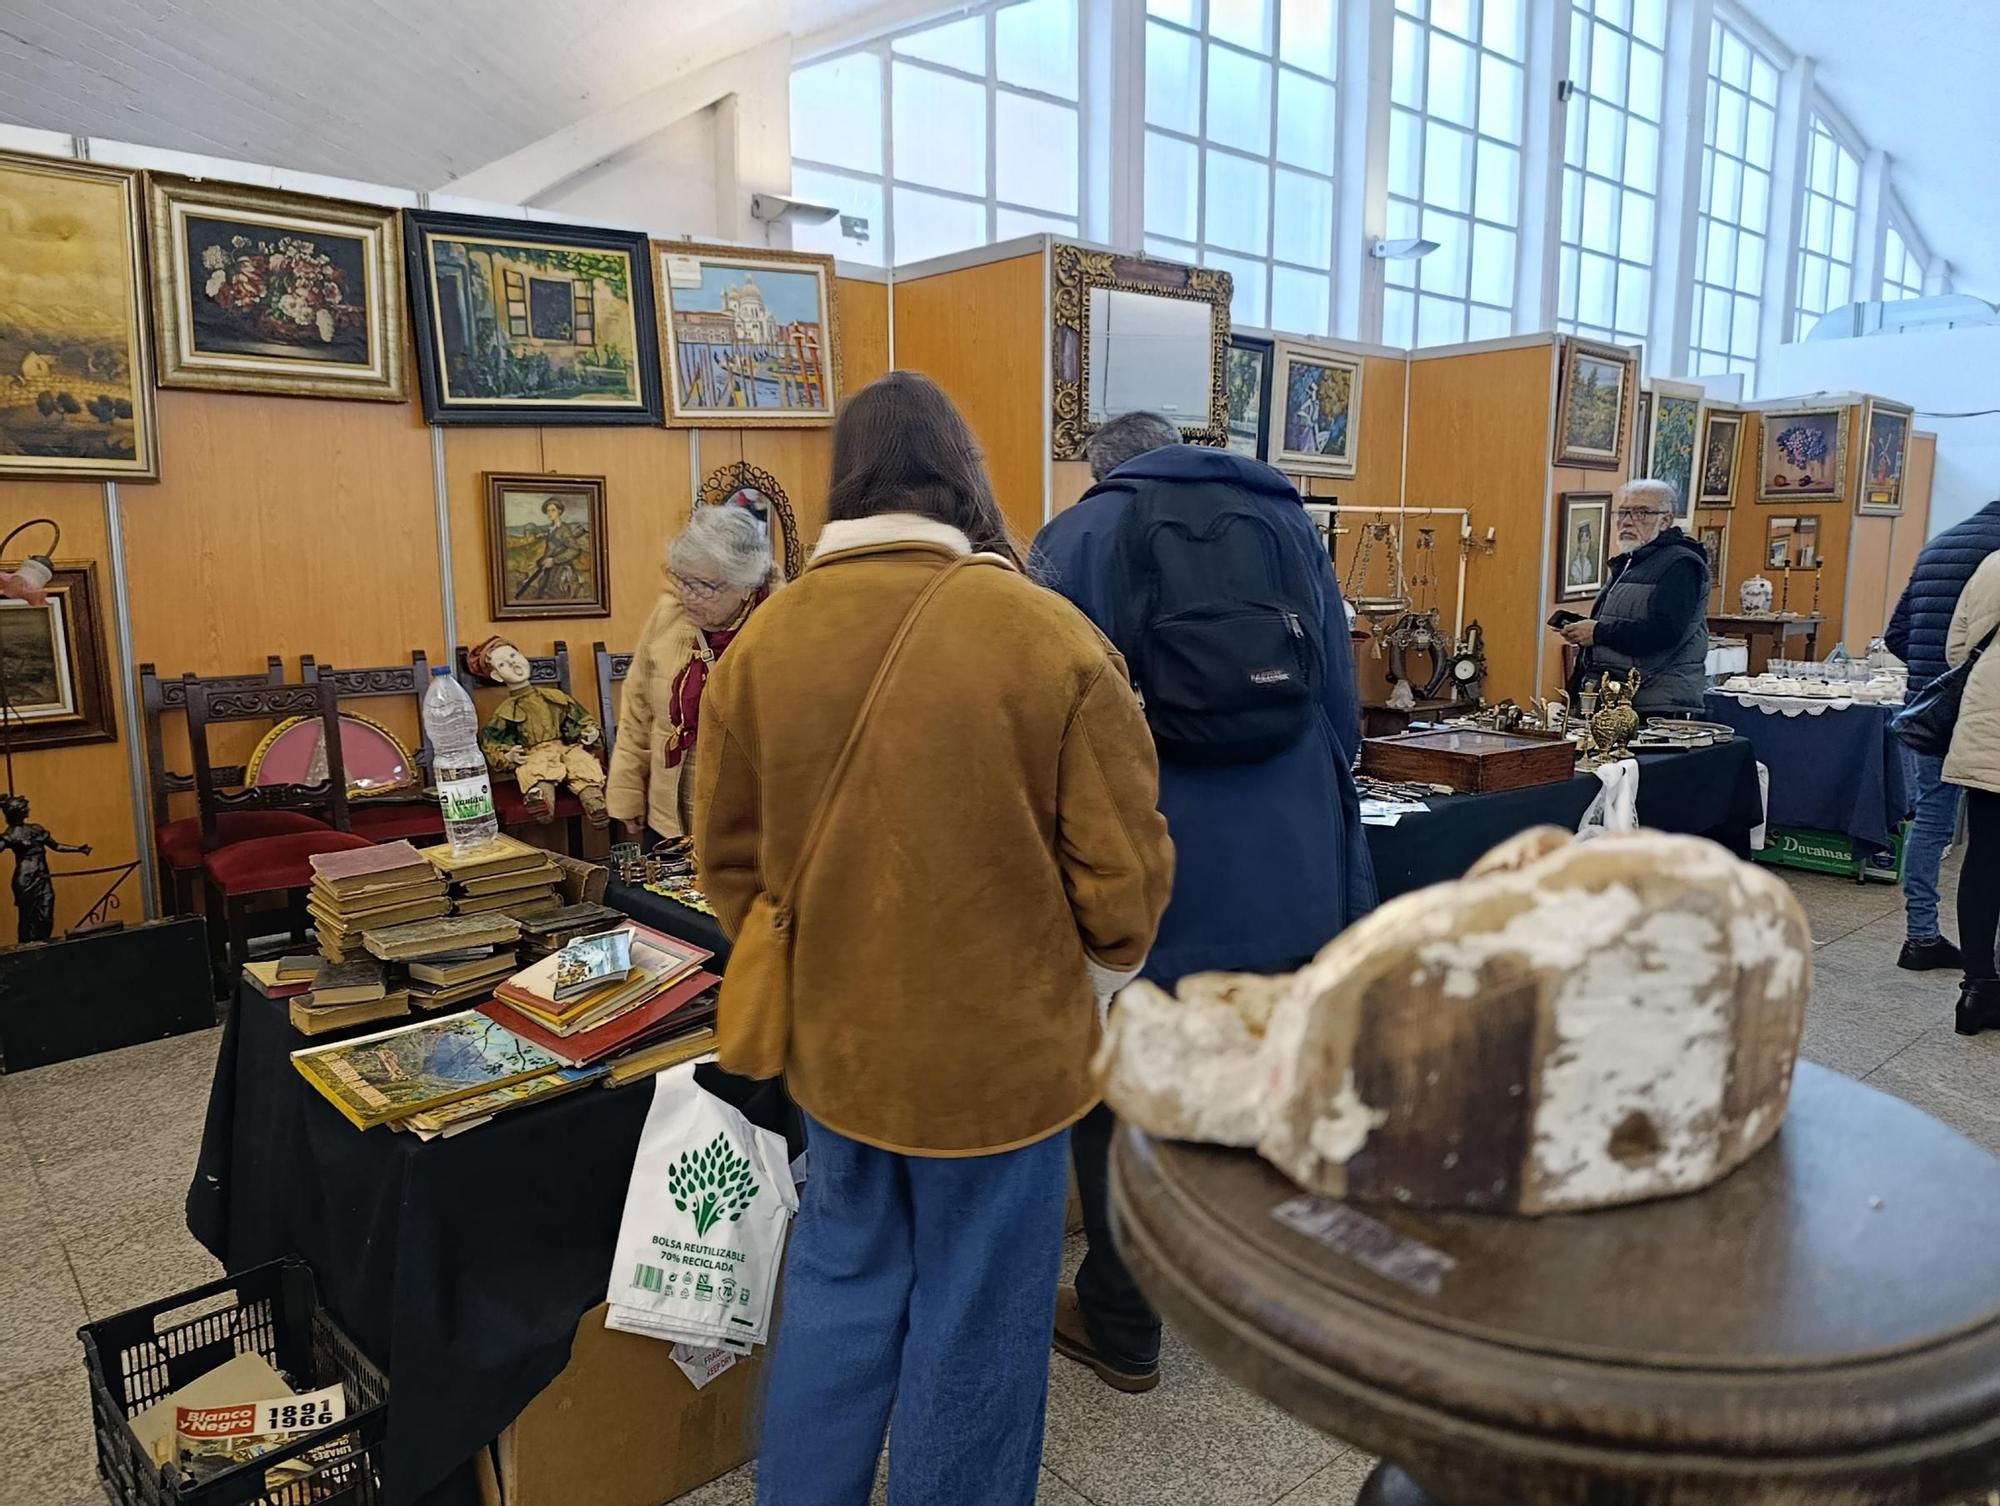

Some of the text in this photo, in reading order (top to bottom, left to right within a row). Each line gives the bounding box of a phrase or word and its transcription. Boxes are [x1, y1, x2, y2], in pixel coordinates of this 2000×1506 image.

[652, 1235, 746, 1263] BOLSA REUTILIZABLE
[660, 1250, 734, 1273] 70% RECICLADA
[187, 1409, 251, 1422] Blanco
[269, 1399, 330, 1418] 1891
[191, 1419, 251, 1433] Negro
[268, 1412, 333, 1429] 1966
